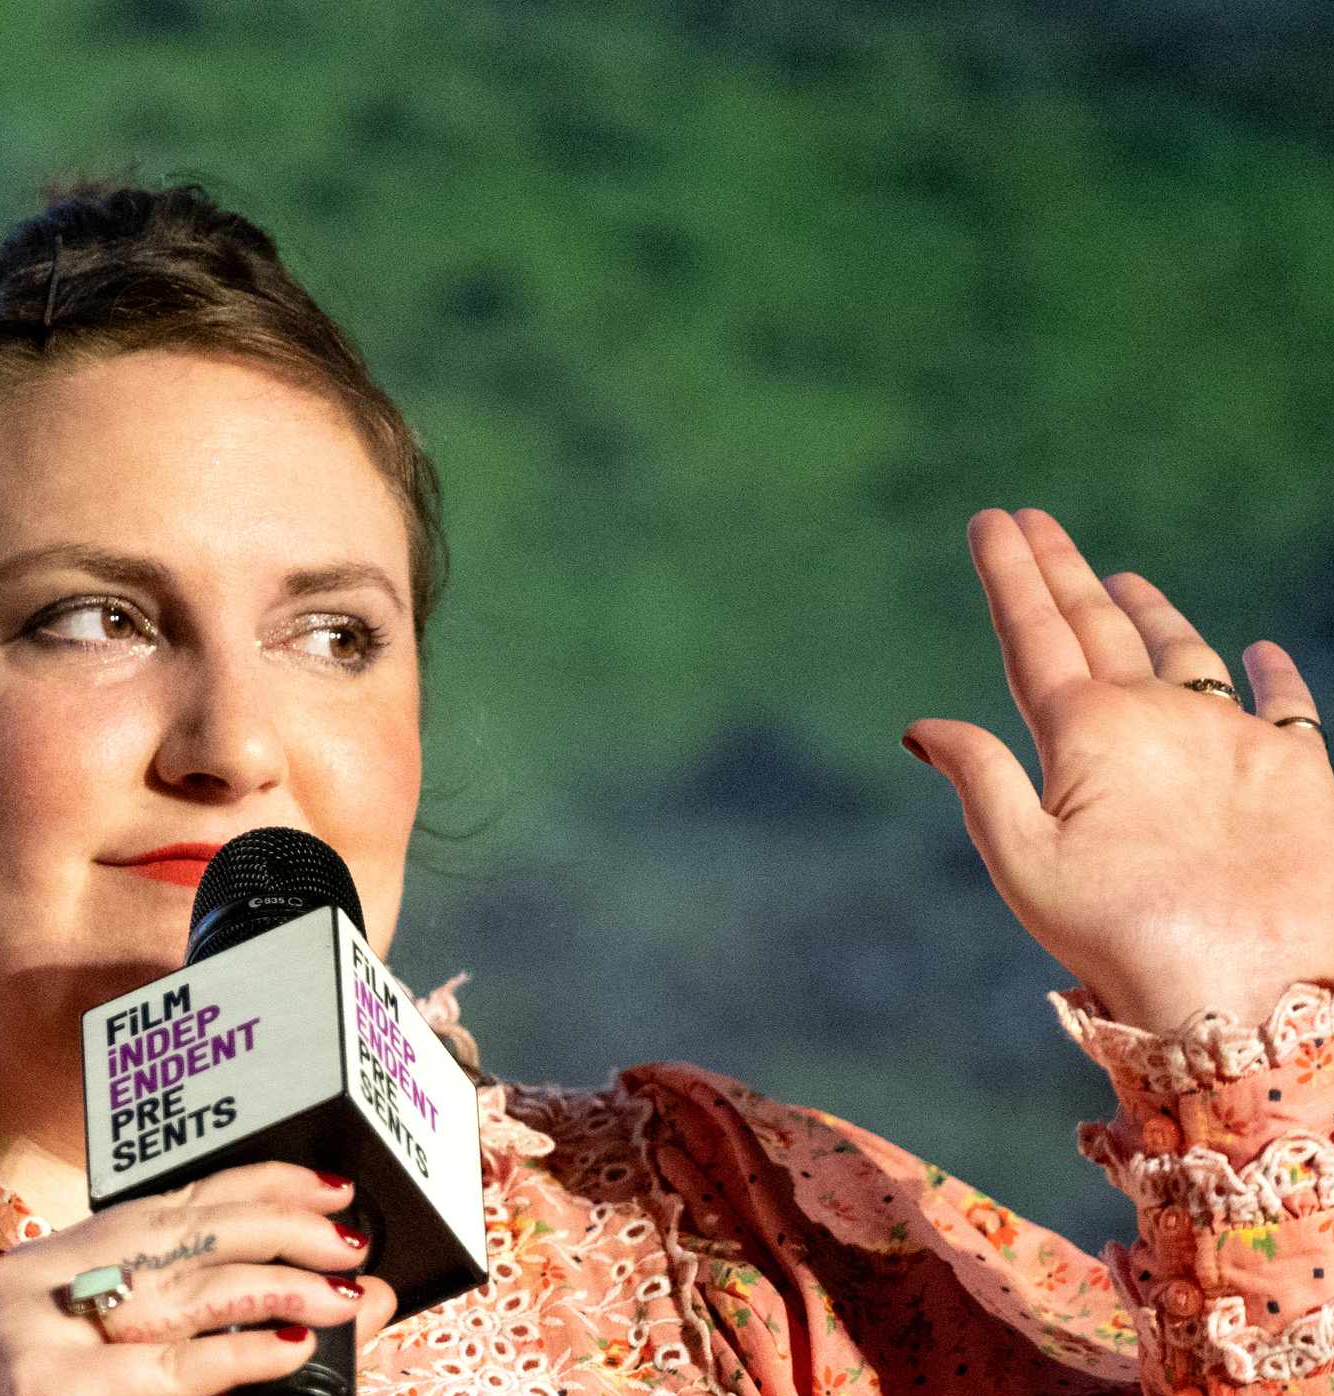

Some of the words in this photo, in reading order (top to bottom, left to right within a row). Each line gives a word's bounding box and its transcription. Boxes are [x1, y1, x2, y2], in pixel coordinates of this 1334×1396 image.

[264, 897, 285, 905] 835
[106, 983, 191, 1046] FiLM
[352, 939, 399, 1025] FiLM
[354, 971, 416, 1066] iNDEP
[107, 1004, 221, 1079] iNDEP
[109, 1016, 260, 1110] ENDENT
[356, 1002, 439, 1133] ENDENT
[358, 1034, 399, 1114] PRE
[111, 1083, 185, 1142] PRE
[112, 1095, 237, 1173] SENTS
[360, 1069, 429, 1179] SENTS
